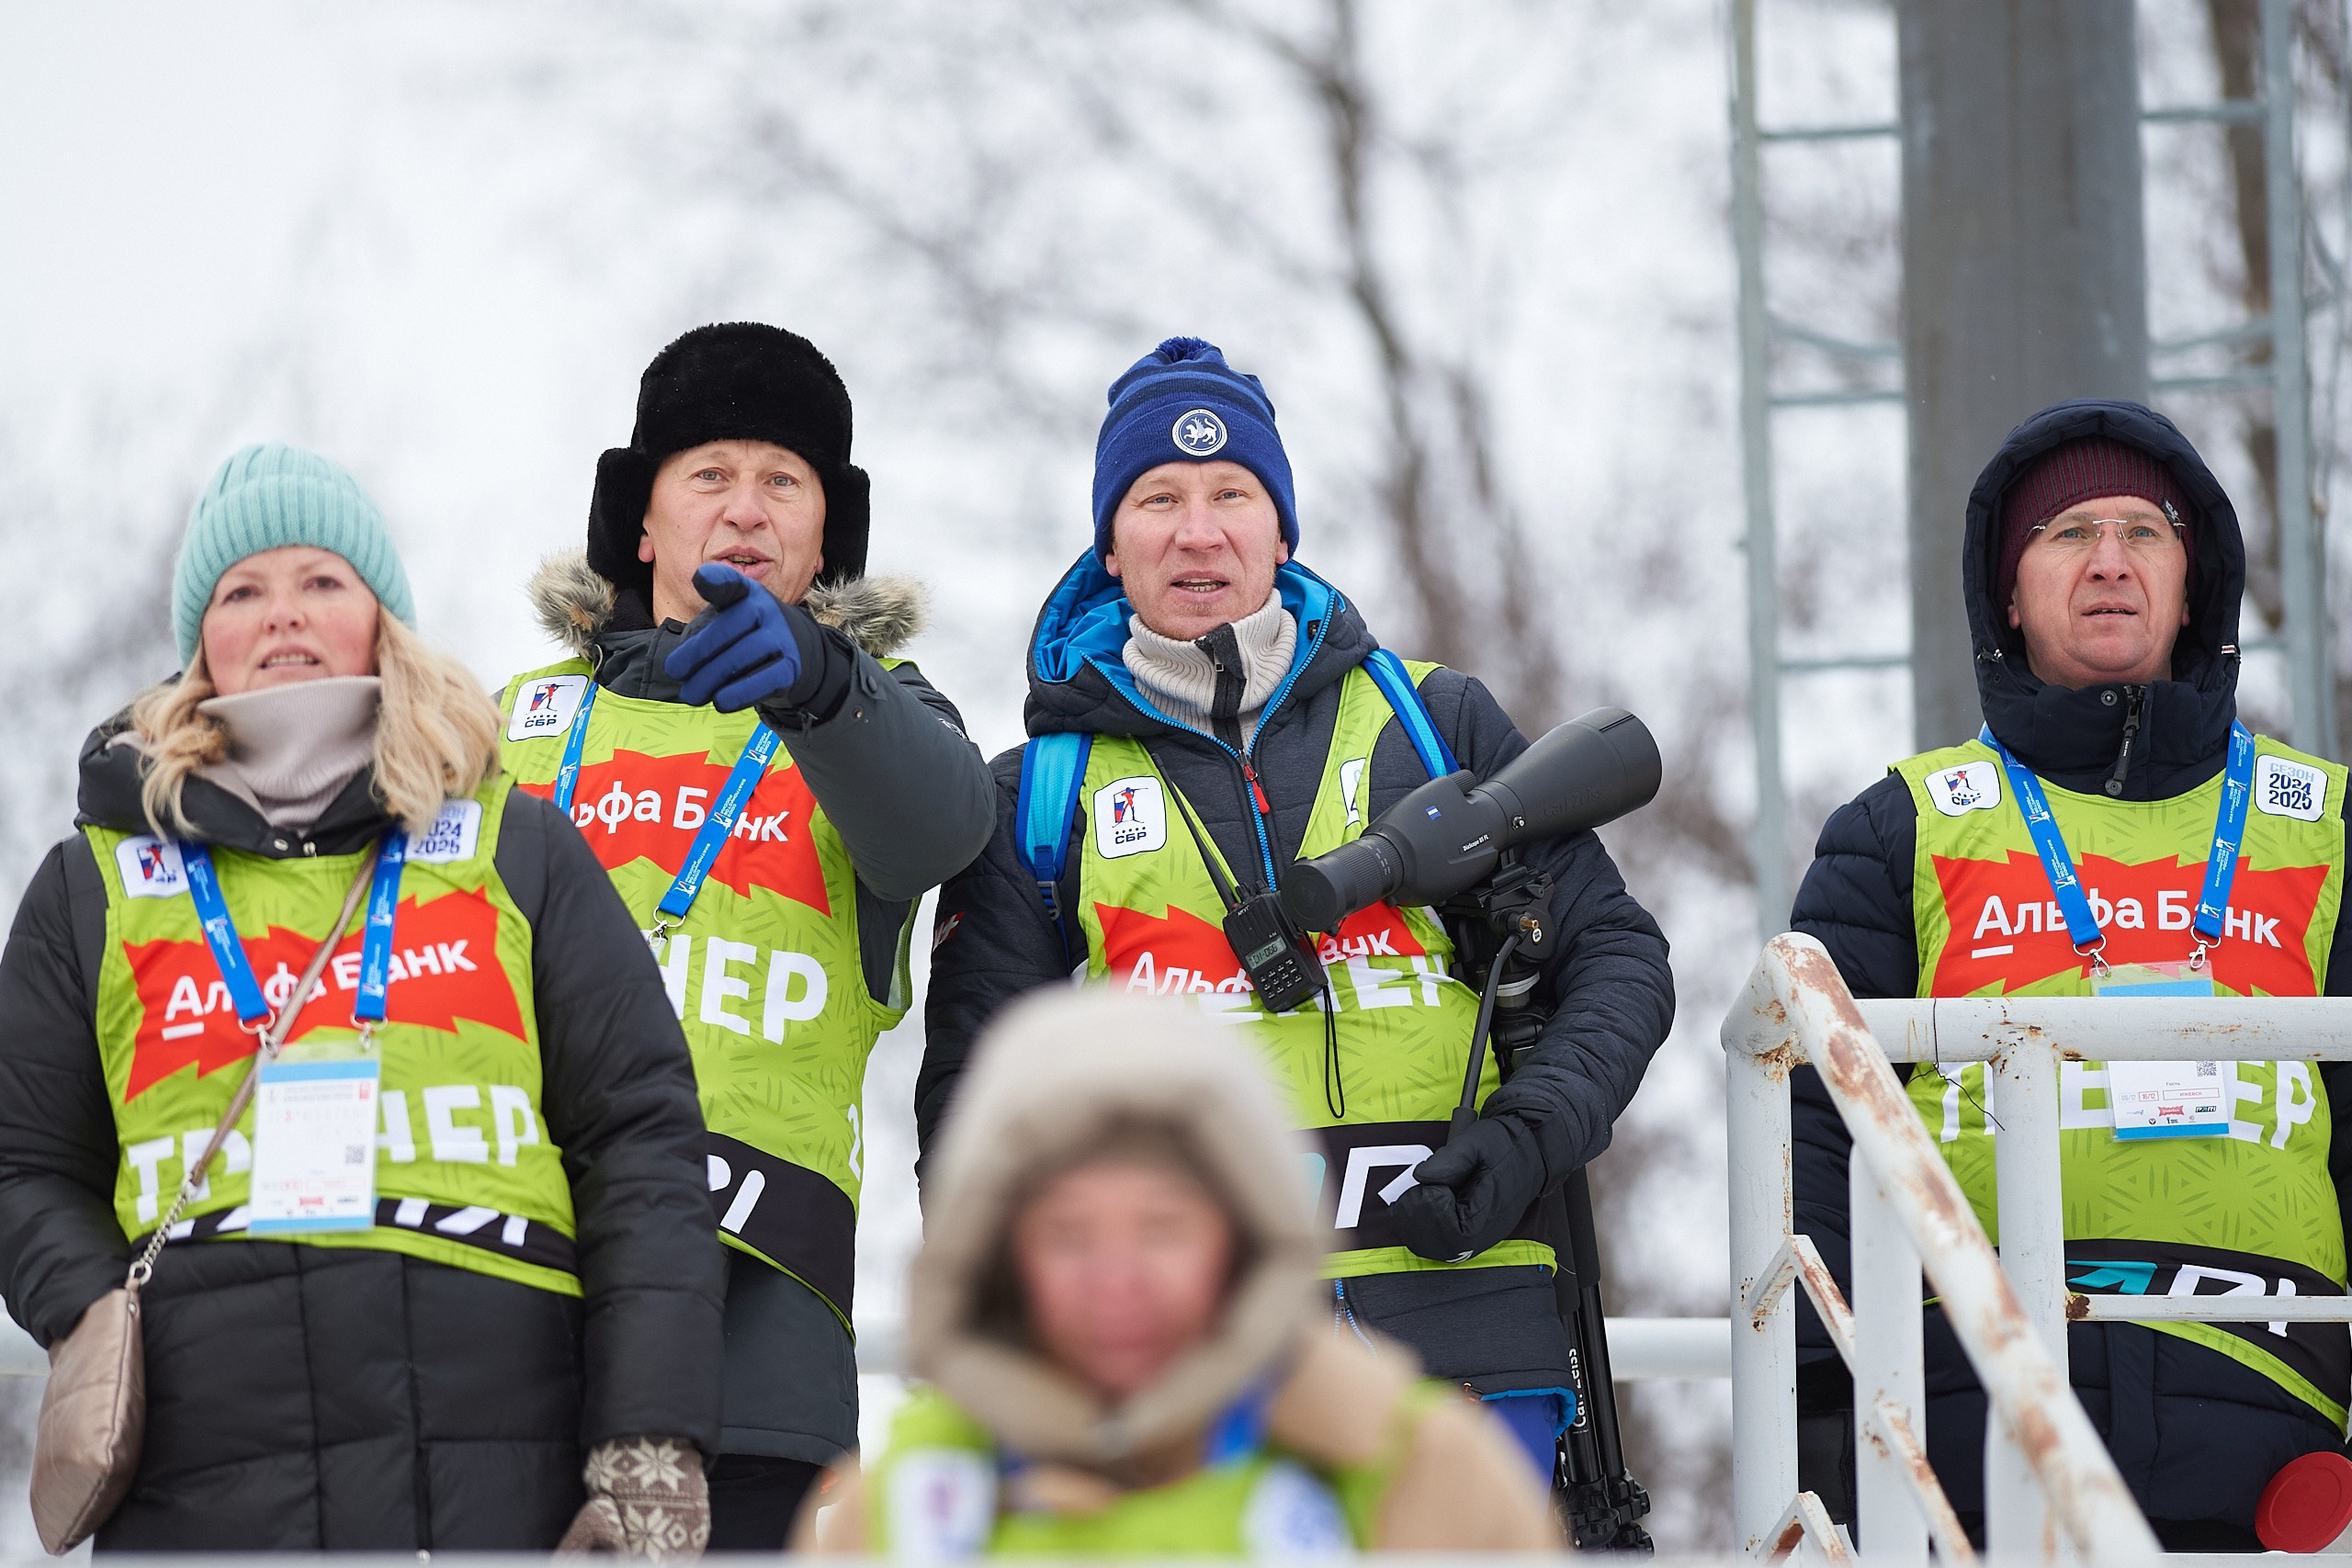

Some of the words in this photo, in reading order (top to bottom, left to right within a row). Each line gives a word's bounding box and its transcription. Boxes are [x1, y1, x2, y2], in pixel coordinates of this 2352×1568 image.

[524, 718, 558, 728] СБР
[2269, 762, 2315, 783] СЕЗОН
[2269, 773, 2312, 795] 2024
[570, 780, 662, 834] ьфа
[673, 785, 790, 842] Бнк
[2268, 789, 2312, 810] 2025
[1114, 831, 1148, 844] СБР
[2157, 889, 2283, 949] Бнк
[1124, 951, 1255, 997] Альф
[1321, 928, 1402, 966] анк
[164, 962, 328, 1022] Алф
[639, 929, 829, 1046] НЕР
[126, 1084, 540, 1224] ТРЕР
[1573, 1393, 1587, 1427] Ca
